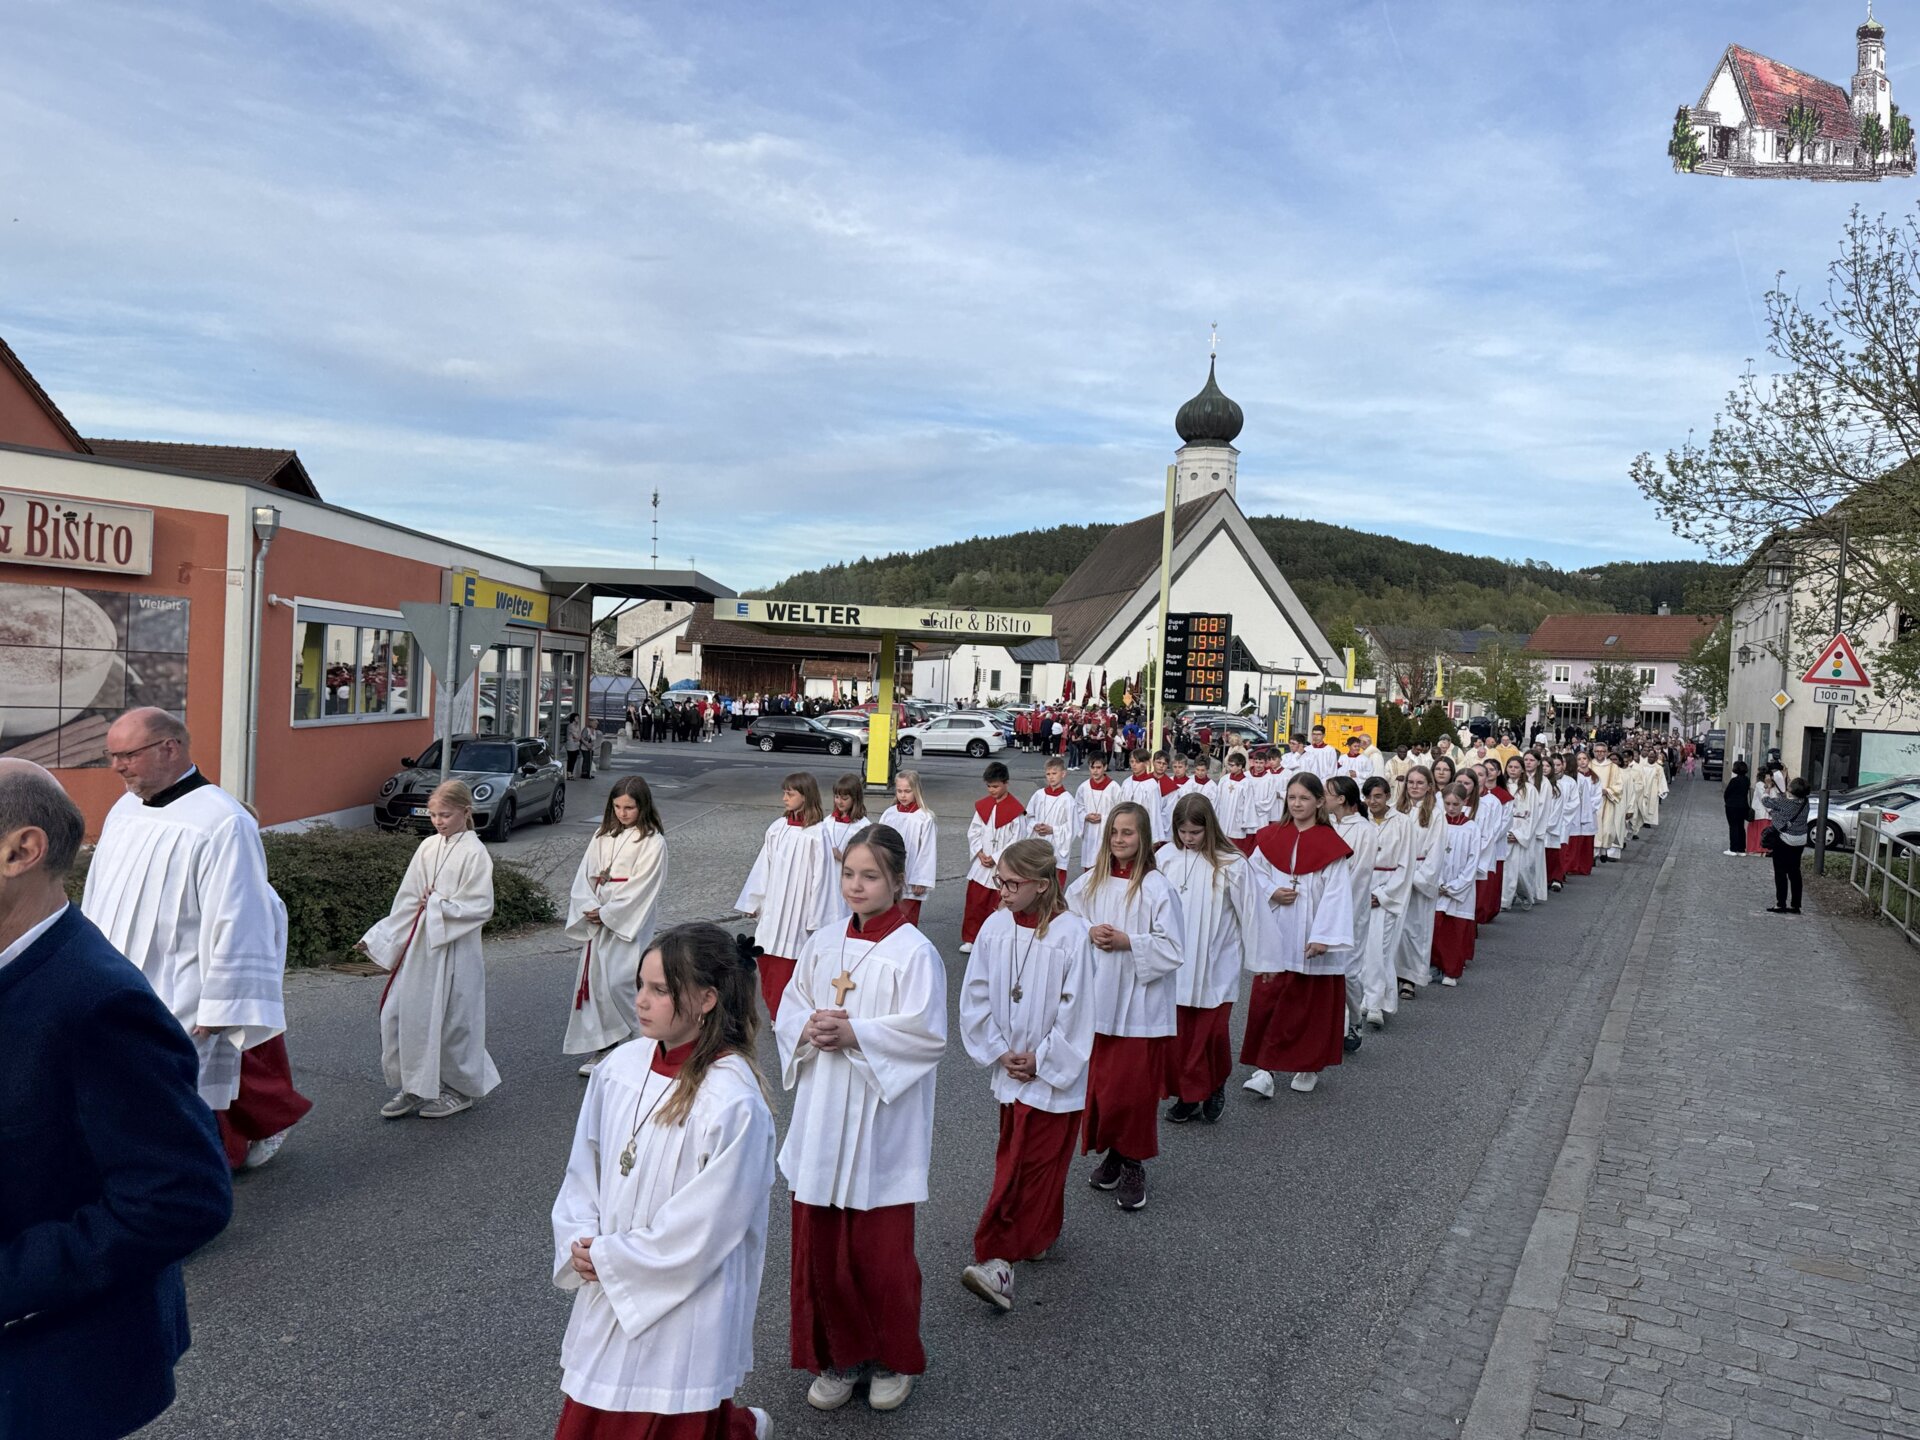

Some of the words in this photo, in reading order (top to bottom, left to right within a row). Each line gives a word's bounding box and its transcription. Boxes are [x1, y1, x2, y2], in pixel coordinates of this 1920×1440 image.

[25, 500, 133, 565] Bistro
[464, 577, 476, 607] E
[496, 591, 534, 617] Welter
[766, 603, 860, 625] WELTER
[968, 614, 979, 631] &
[985, 614, 1031, 633] Bistro
[1821, 691, 1838, 700] 100
